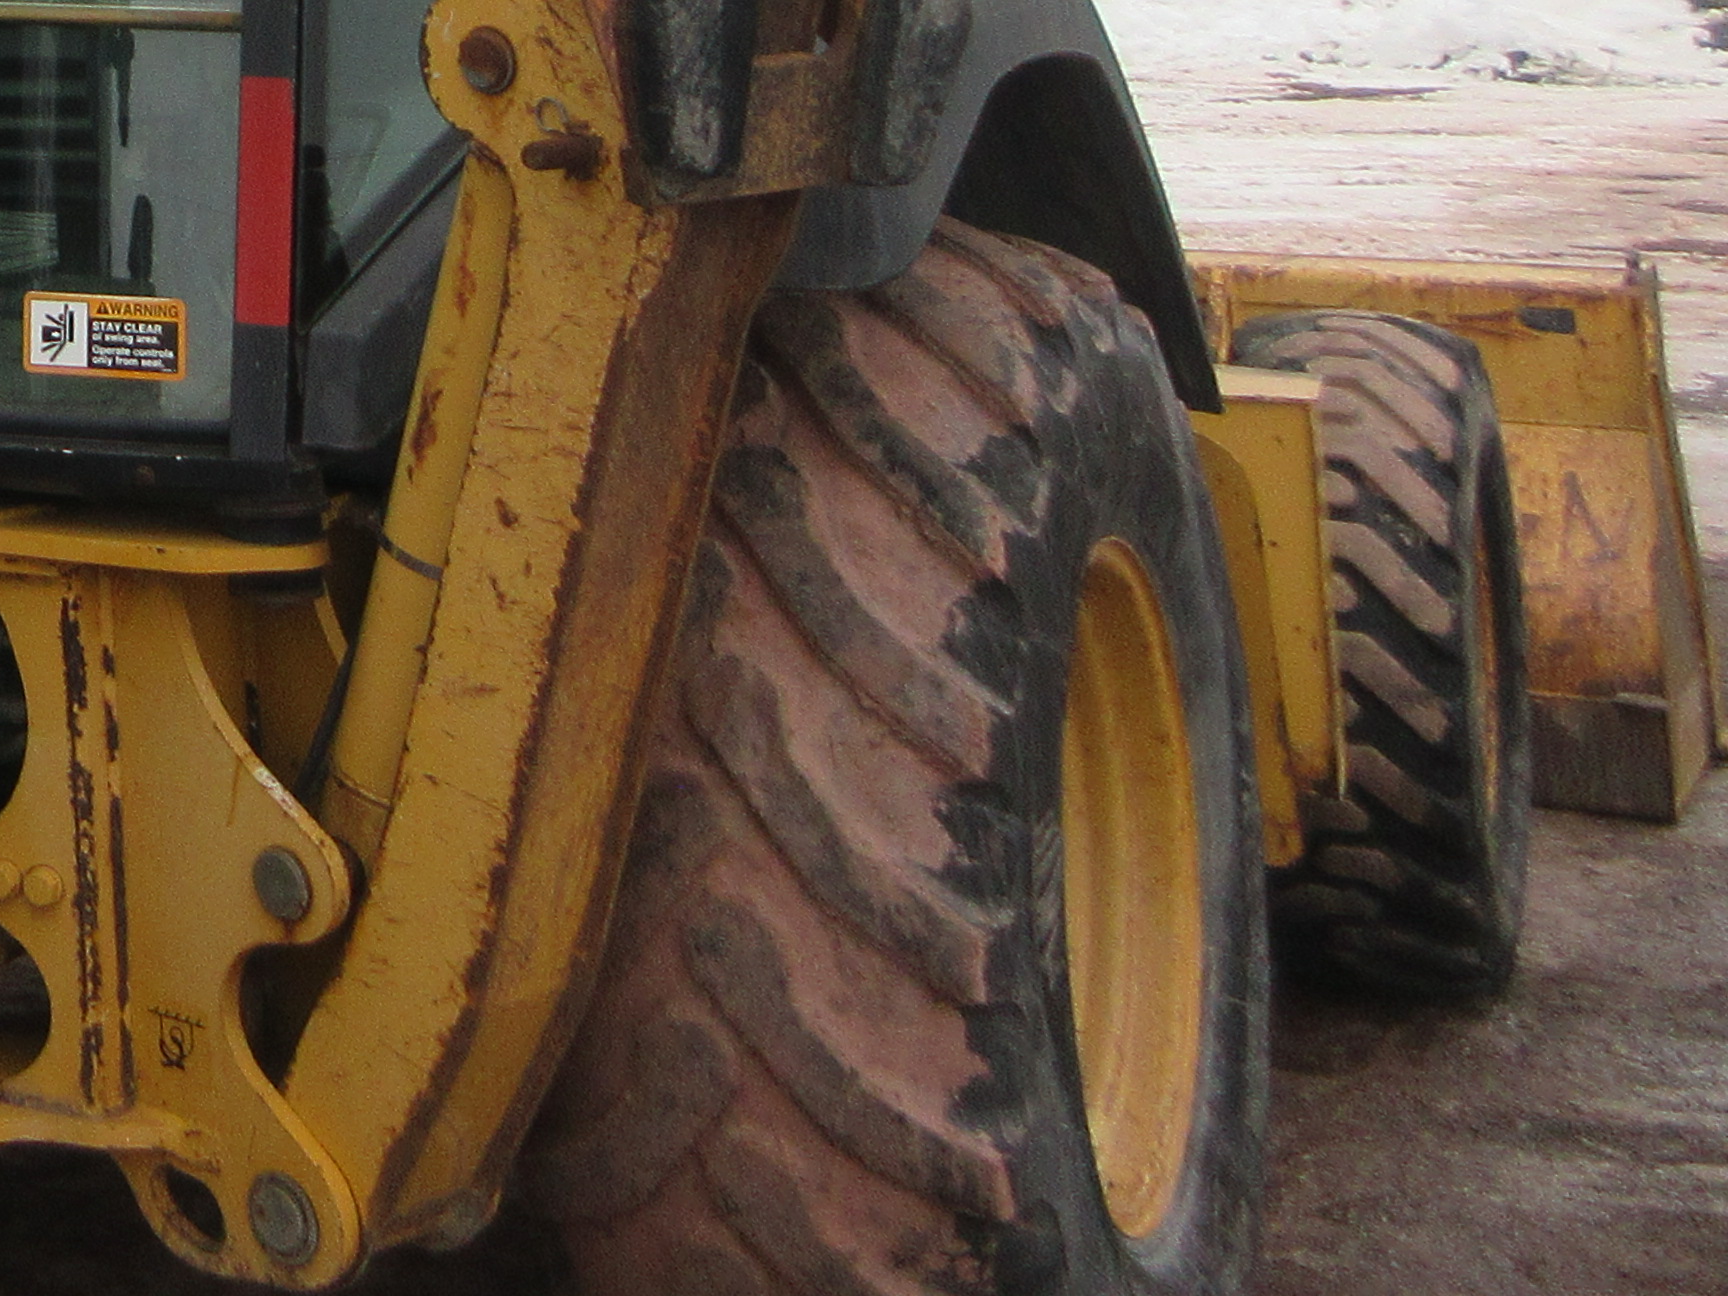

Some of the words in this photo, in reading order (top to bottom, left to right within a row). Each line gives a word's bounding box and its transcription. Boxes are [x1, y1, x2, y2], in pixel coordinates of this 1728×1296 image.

[110, 301, 179, 318] WARNING
[92, 320, 122, 332] STAY
[124, 322, 162, 335] CLEAR
[104, 333, 134, 345] swing
[92, 344, 131, 357] Operate
[132, 348, 175, 359] controls
[115, 355, 140, 366] from
